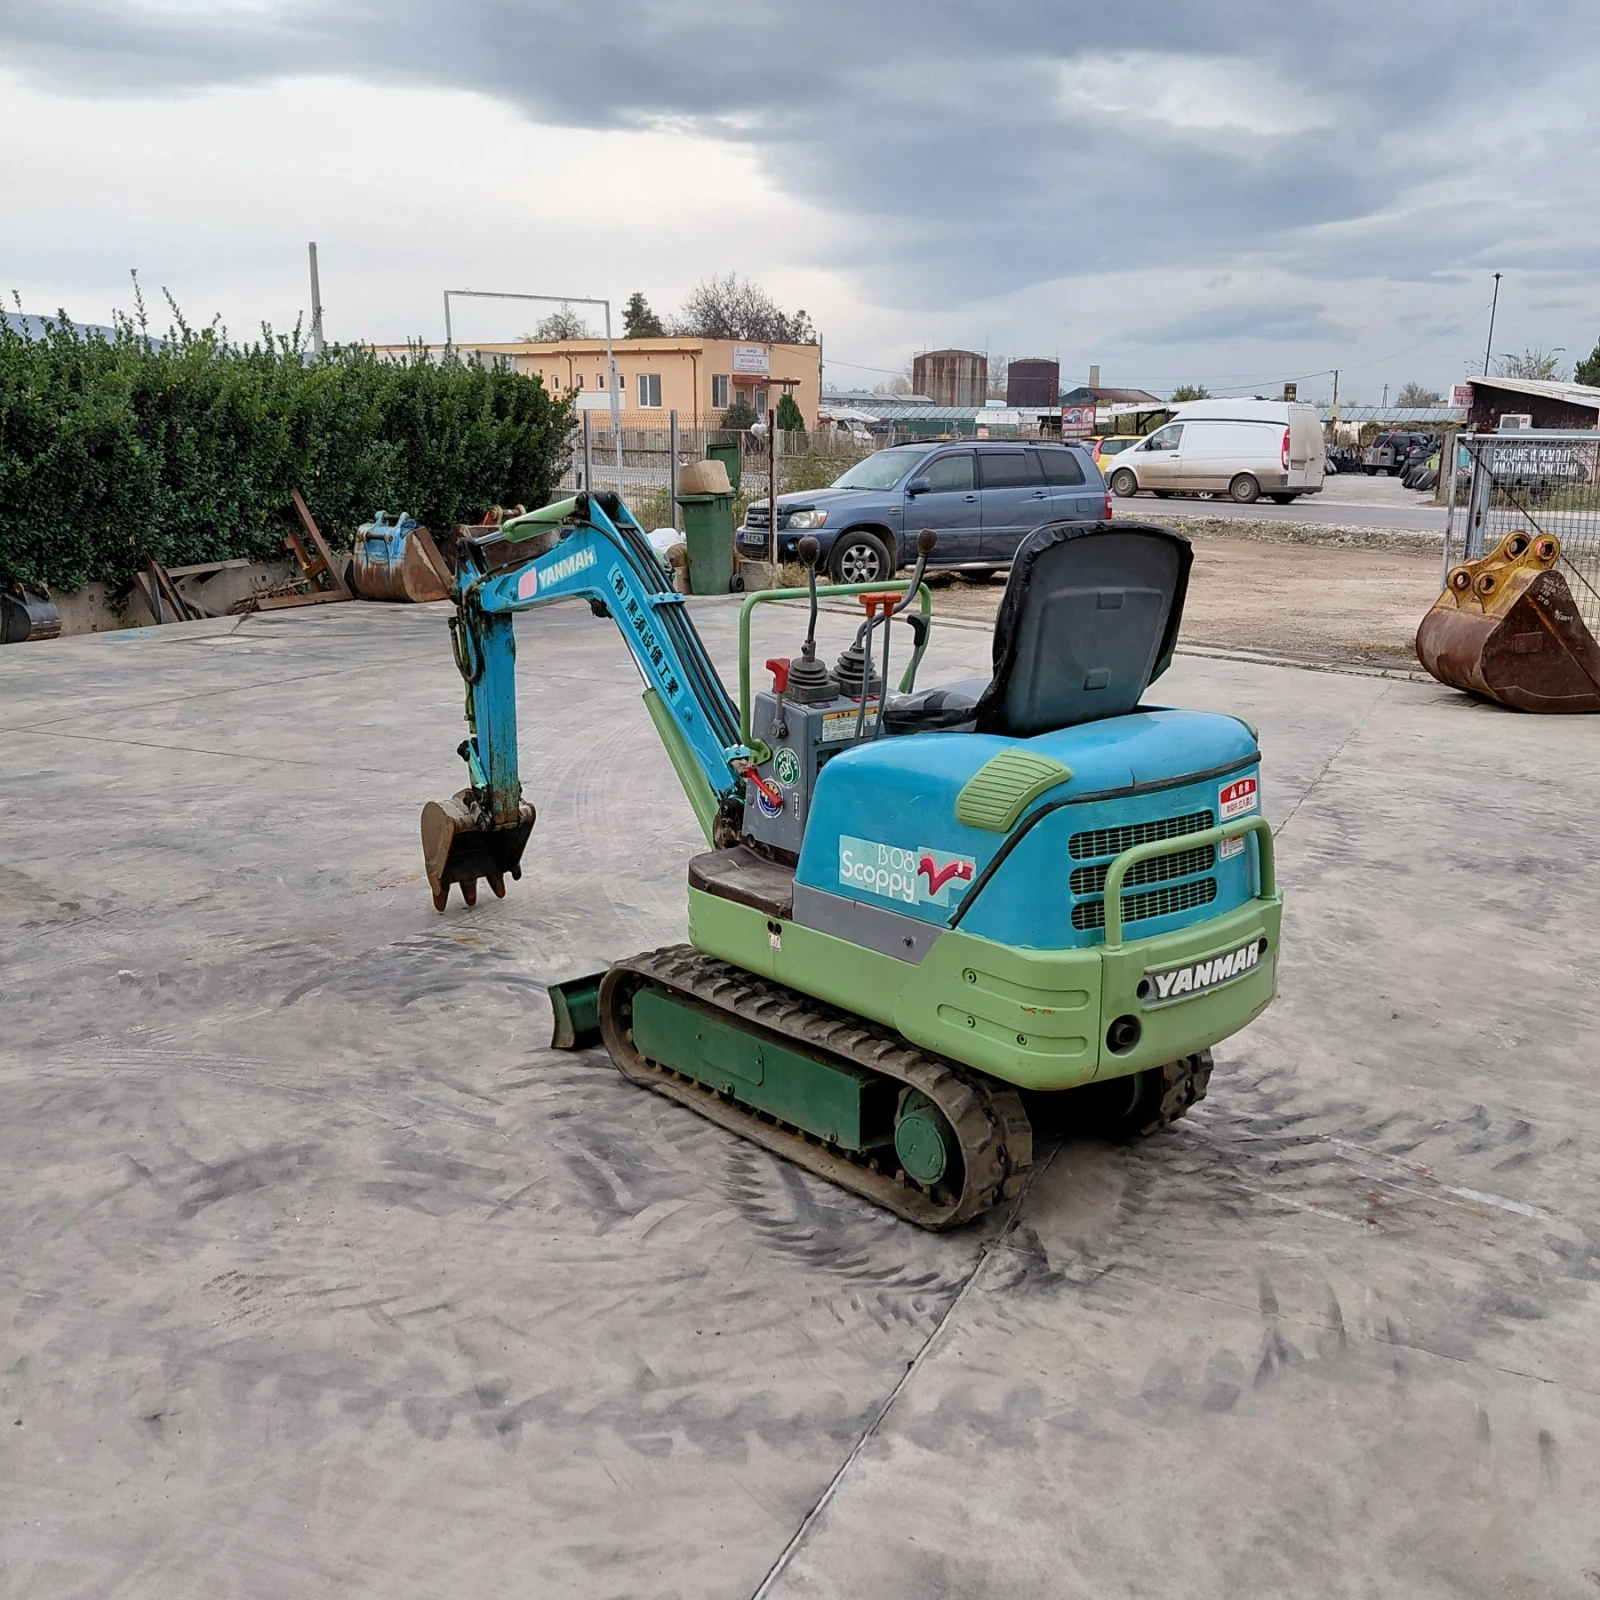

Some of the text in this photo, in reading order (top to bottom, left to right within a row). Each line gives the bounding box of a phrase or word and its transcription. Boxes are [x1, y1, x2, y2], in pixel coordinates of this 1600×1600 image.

[1491, 461, 1538, 474] ИМАТИЧНА
[841, 850, 915, 903] Scoppy
[1154, 941, 1260, 998] YANMAR
